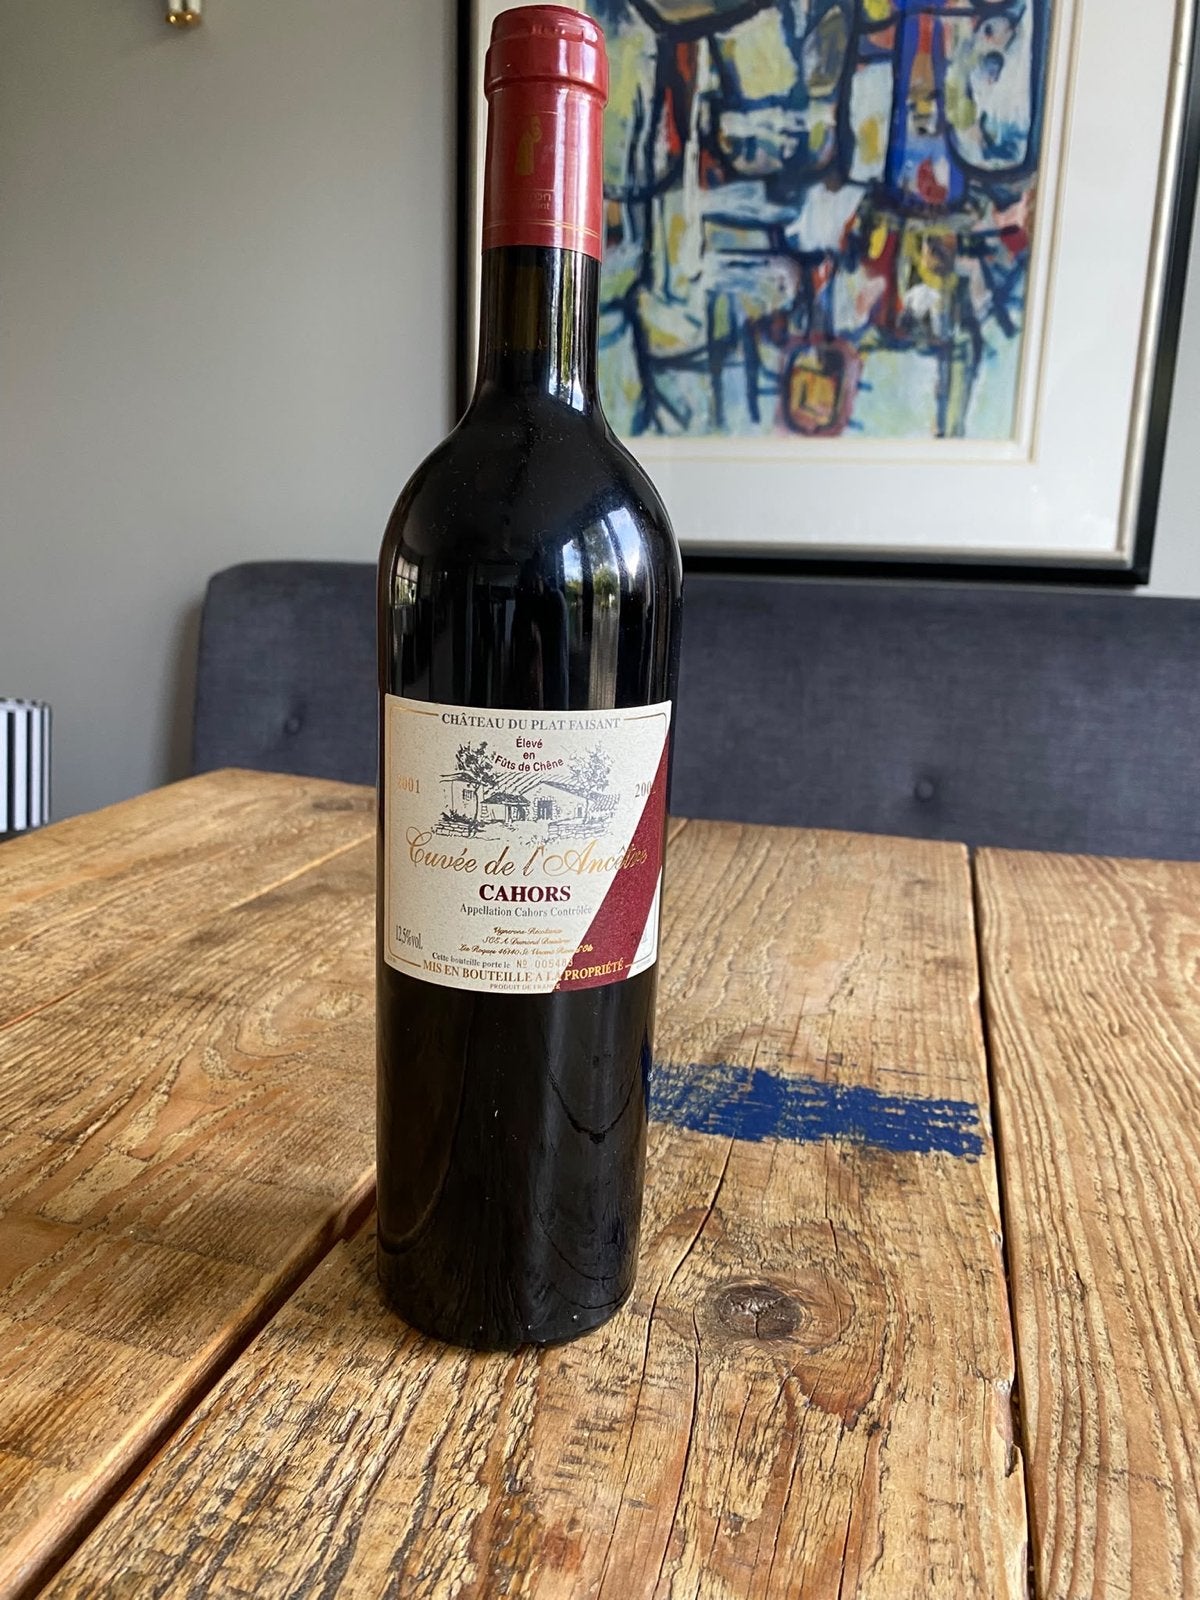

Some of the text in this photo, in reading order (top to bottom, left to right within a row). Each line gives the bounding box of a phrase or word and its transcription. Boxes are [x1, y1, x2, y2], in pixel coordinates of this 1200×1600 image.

[441, 713, 621, 731] CHÂTEAU DU PLAT FAISANT
[516, 736, 543, 749] Élevé
[494, 755, 564, 772] Fûts de Chêne
[522, 752, 536, 760] en
[405, 826, 478, 873] Cuvée
[484, 846, 516, 876] de
[479, 884, 571, 902] CAHORS
[460, 903, 593, 918] Appellation Cahors Contrôlée
[423, 959, 442, 973] MIS
[444, 964, 460, 977] EN
[462, 966, 533, 982] BOUTEILLE
[564, 957, 624, 981] PROPRIÉTÉ
[432, 951, 450, 963] Cette
[450, 954, 480, 967] bouteille
[482, 959, 501, 970] porte
[502, 960, 511, 969] le
